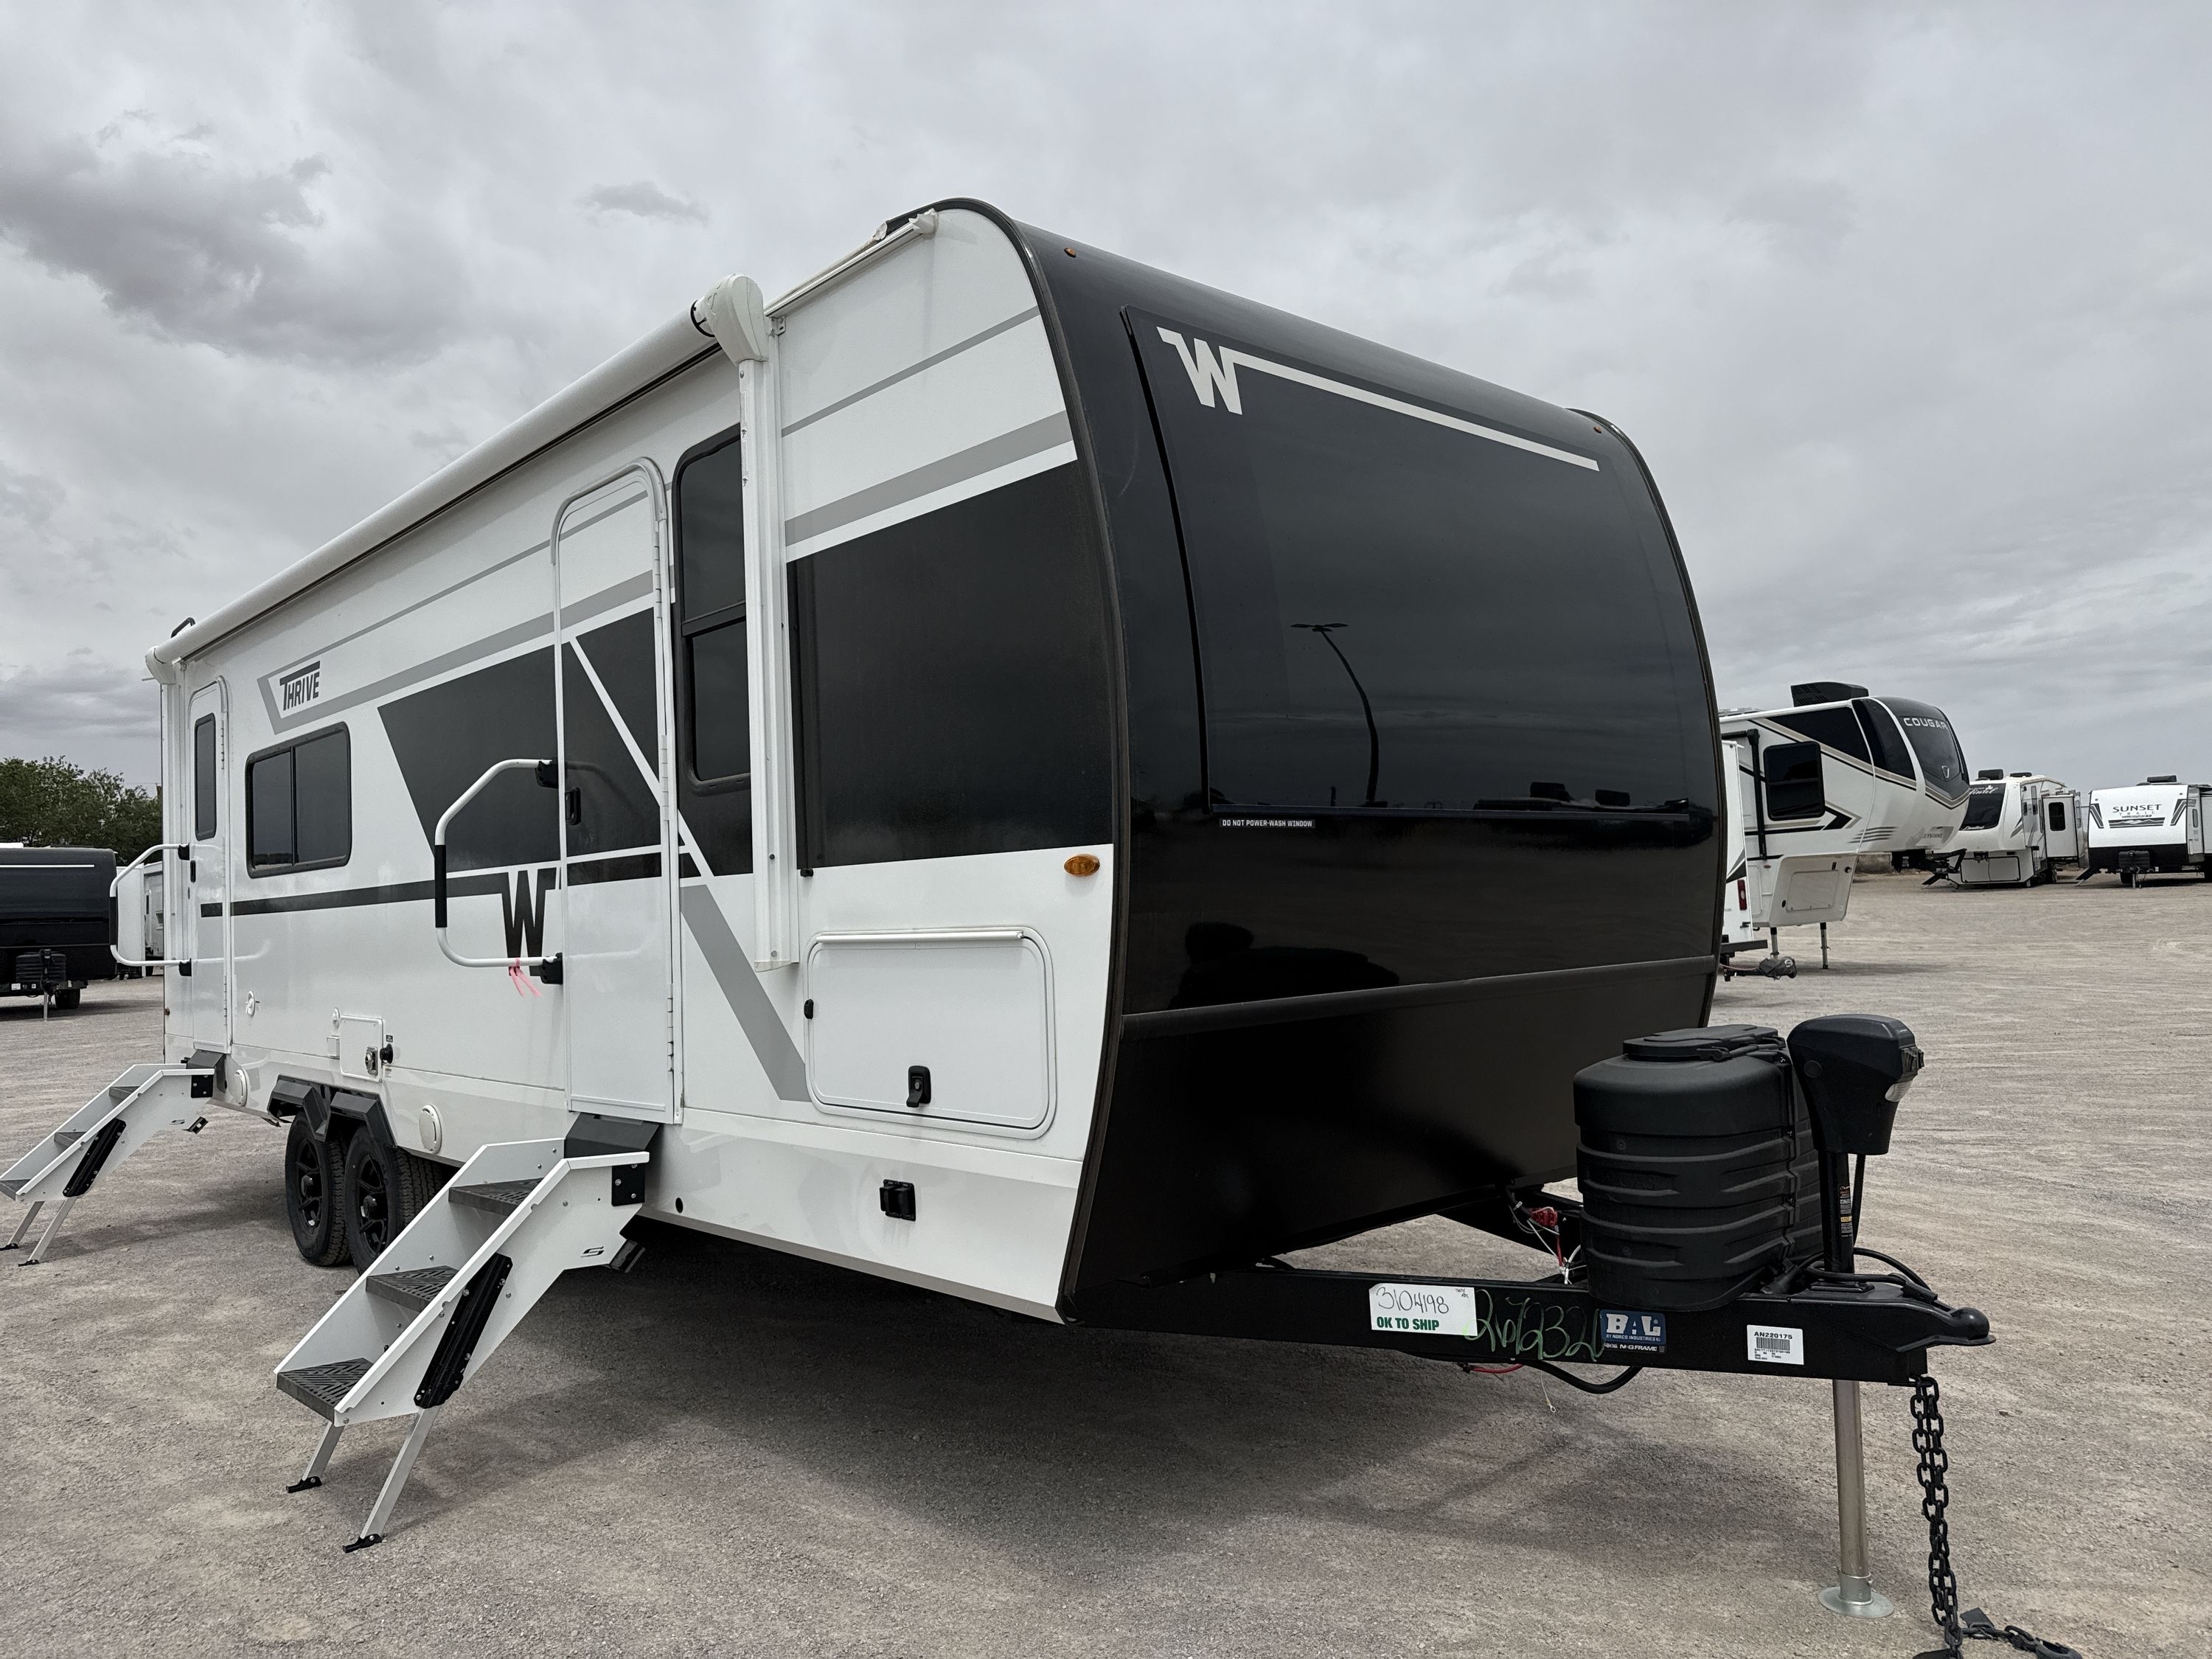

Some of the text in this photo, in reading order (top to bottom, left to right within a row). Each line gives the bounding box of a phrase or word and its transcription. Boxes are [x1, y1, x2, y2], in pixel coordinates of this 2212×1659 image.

[279, 660, 321, 711] THRIVE
[1903, 717, 1948, 730] COUGAR
[2112, 804, 2162, 813] SUNSET
[1377, 1287, 1449, 1314] 3104198
[1377, 1316, 1440, 1331] OK TO SHIP
[1606, 1313, 1661, 1336] BAL
[1754, 1331, 1792, 1340] AN220175
